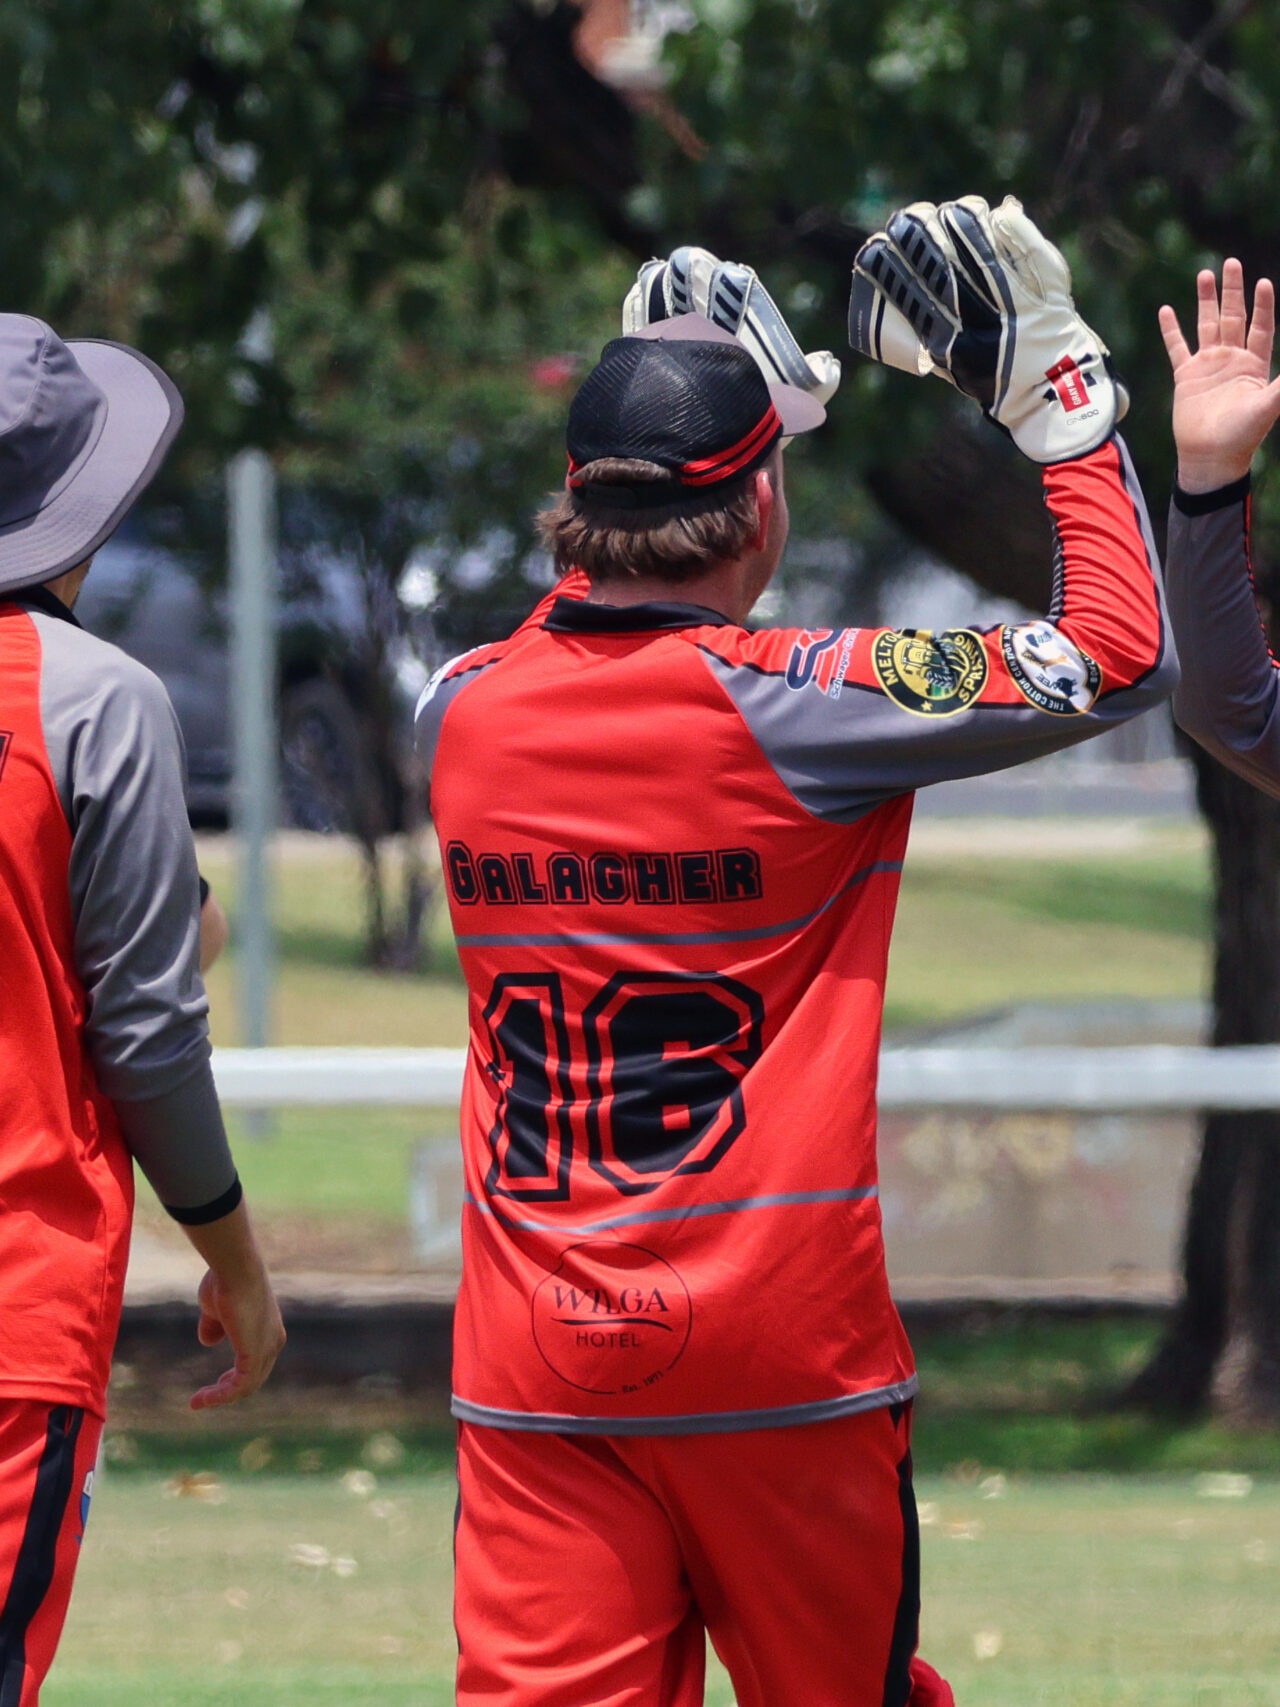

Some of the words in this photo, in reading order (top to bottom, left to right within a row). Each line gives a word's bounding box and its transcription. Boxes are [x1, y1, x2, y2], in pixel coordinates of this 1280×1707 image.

[878, 634, 899, 686] MELTO
[1018, 676, 1048, 705] COTTON
[1048, 700, 1065, 711] THE
[447, 839, 763, 906] GALAGHER
[482, 970, 766, 1202] 16
[553, 1285, 669, 1315] WILGA
[576, 1330, 640, 1348] HOTEL
